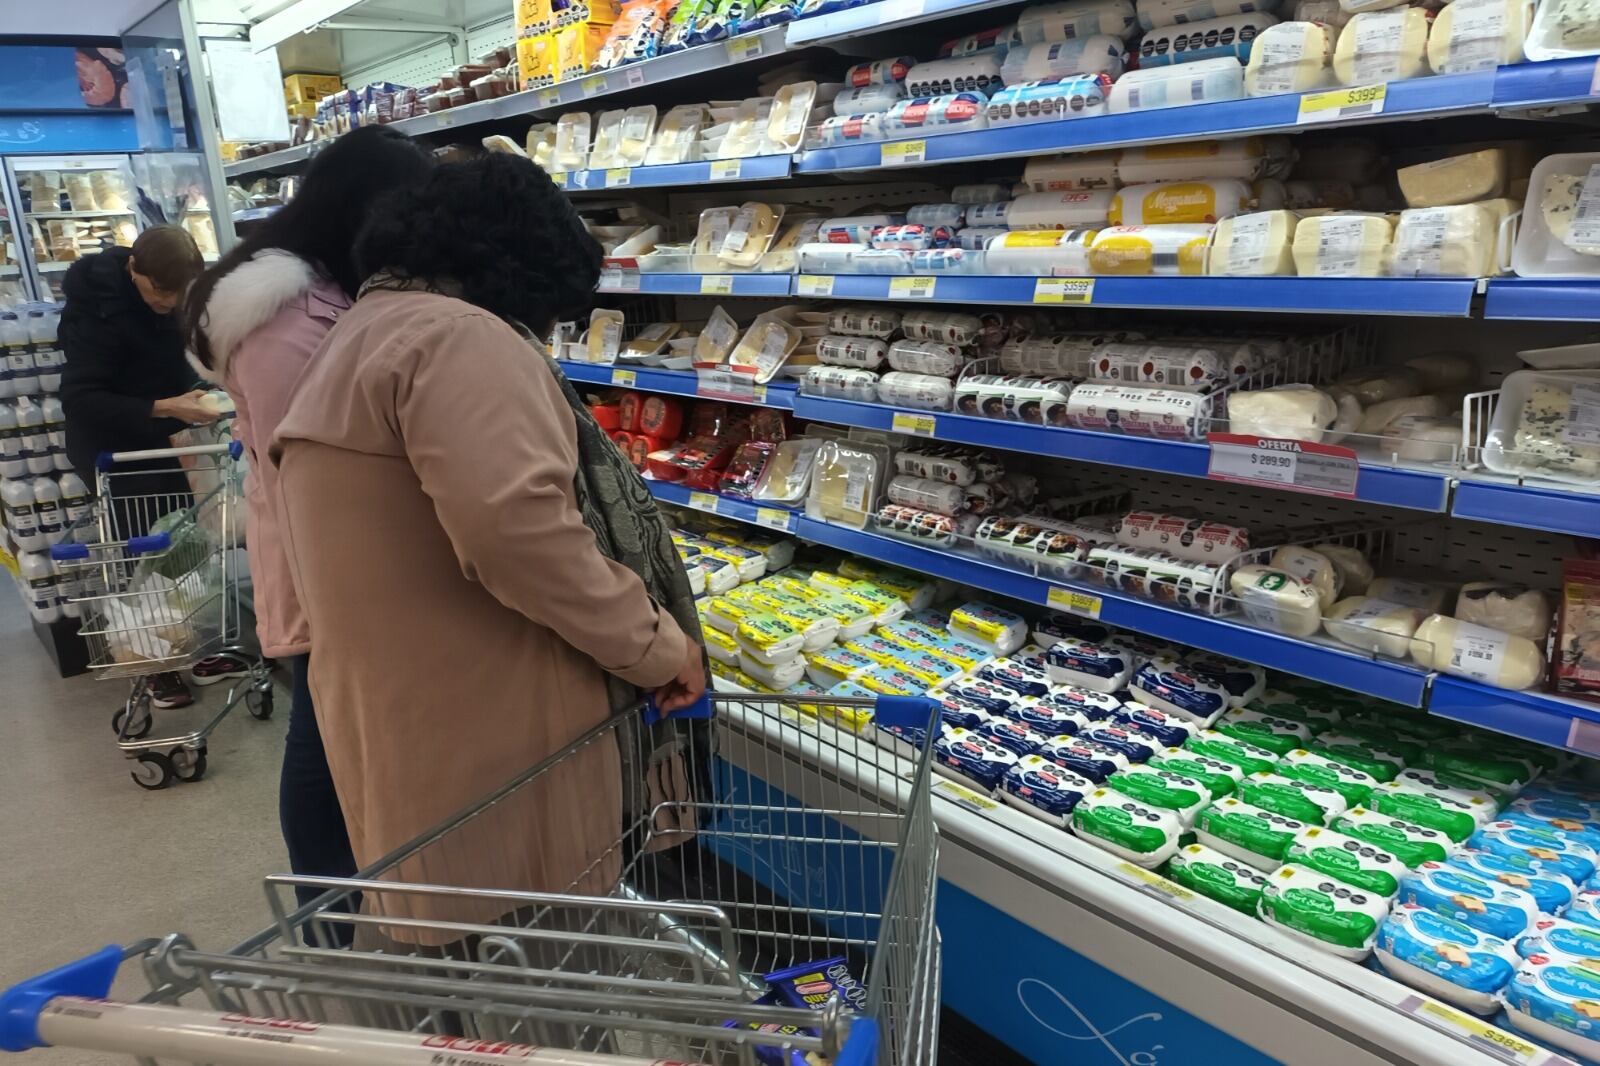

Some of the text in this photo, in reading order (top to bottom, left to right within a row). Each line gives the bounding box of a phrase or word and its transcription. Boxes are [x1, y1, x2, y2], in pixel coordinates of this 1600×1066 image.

[1257, 439, 1302, 452] OFERTA
[1251, 453, 1257, 464] $
[1260, 455, 1290, 468] 289.90
